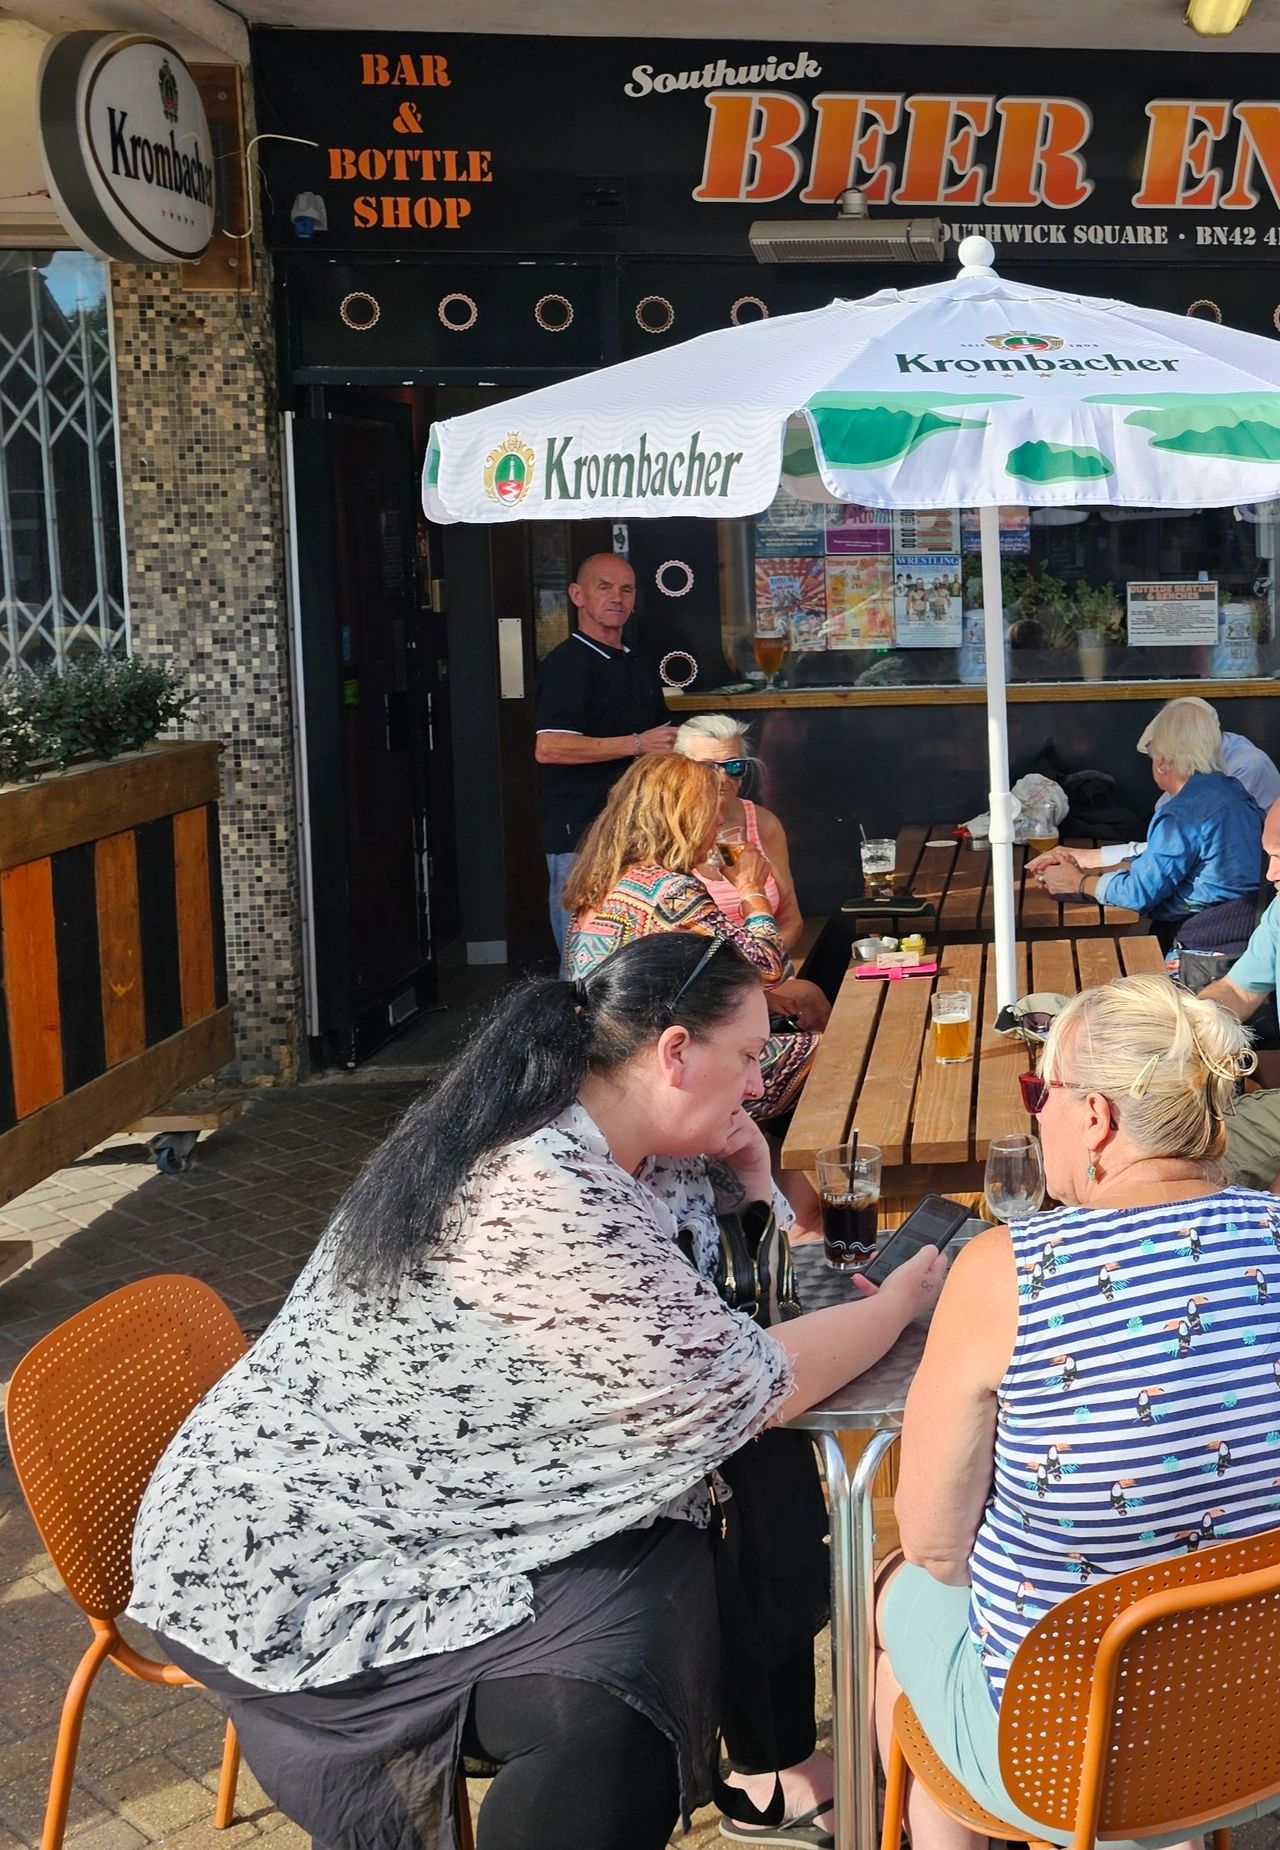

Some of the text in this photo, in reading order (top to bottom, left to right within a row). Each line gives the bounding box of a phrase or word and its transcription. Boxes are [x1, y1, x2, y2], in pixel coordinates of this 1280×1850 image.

[363, 54, 450, 87] BAR
[625, 52, 821, 99] Southwick
[393, 102, 423, 134] &
[107, 106, 213, 208] Krombacher
[329, 148, 494, 183] BOTTLE
[692, 91, 1094, 209] BEER
[353, 196, 472, 229] SHOP
[941, 223, 1067, 244] OUTHWICK
[1073, 225, 1168, 245] SQUARE
[1196, 226, 1256, 245] BN42
[895, 353, 1180, 373] Krombacher
[544, 431, 744, 500] Krombacher
[896, 557, 960, 566] WRESTLING
